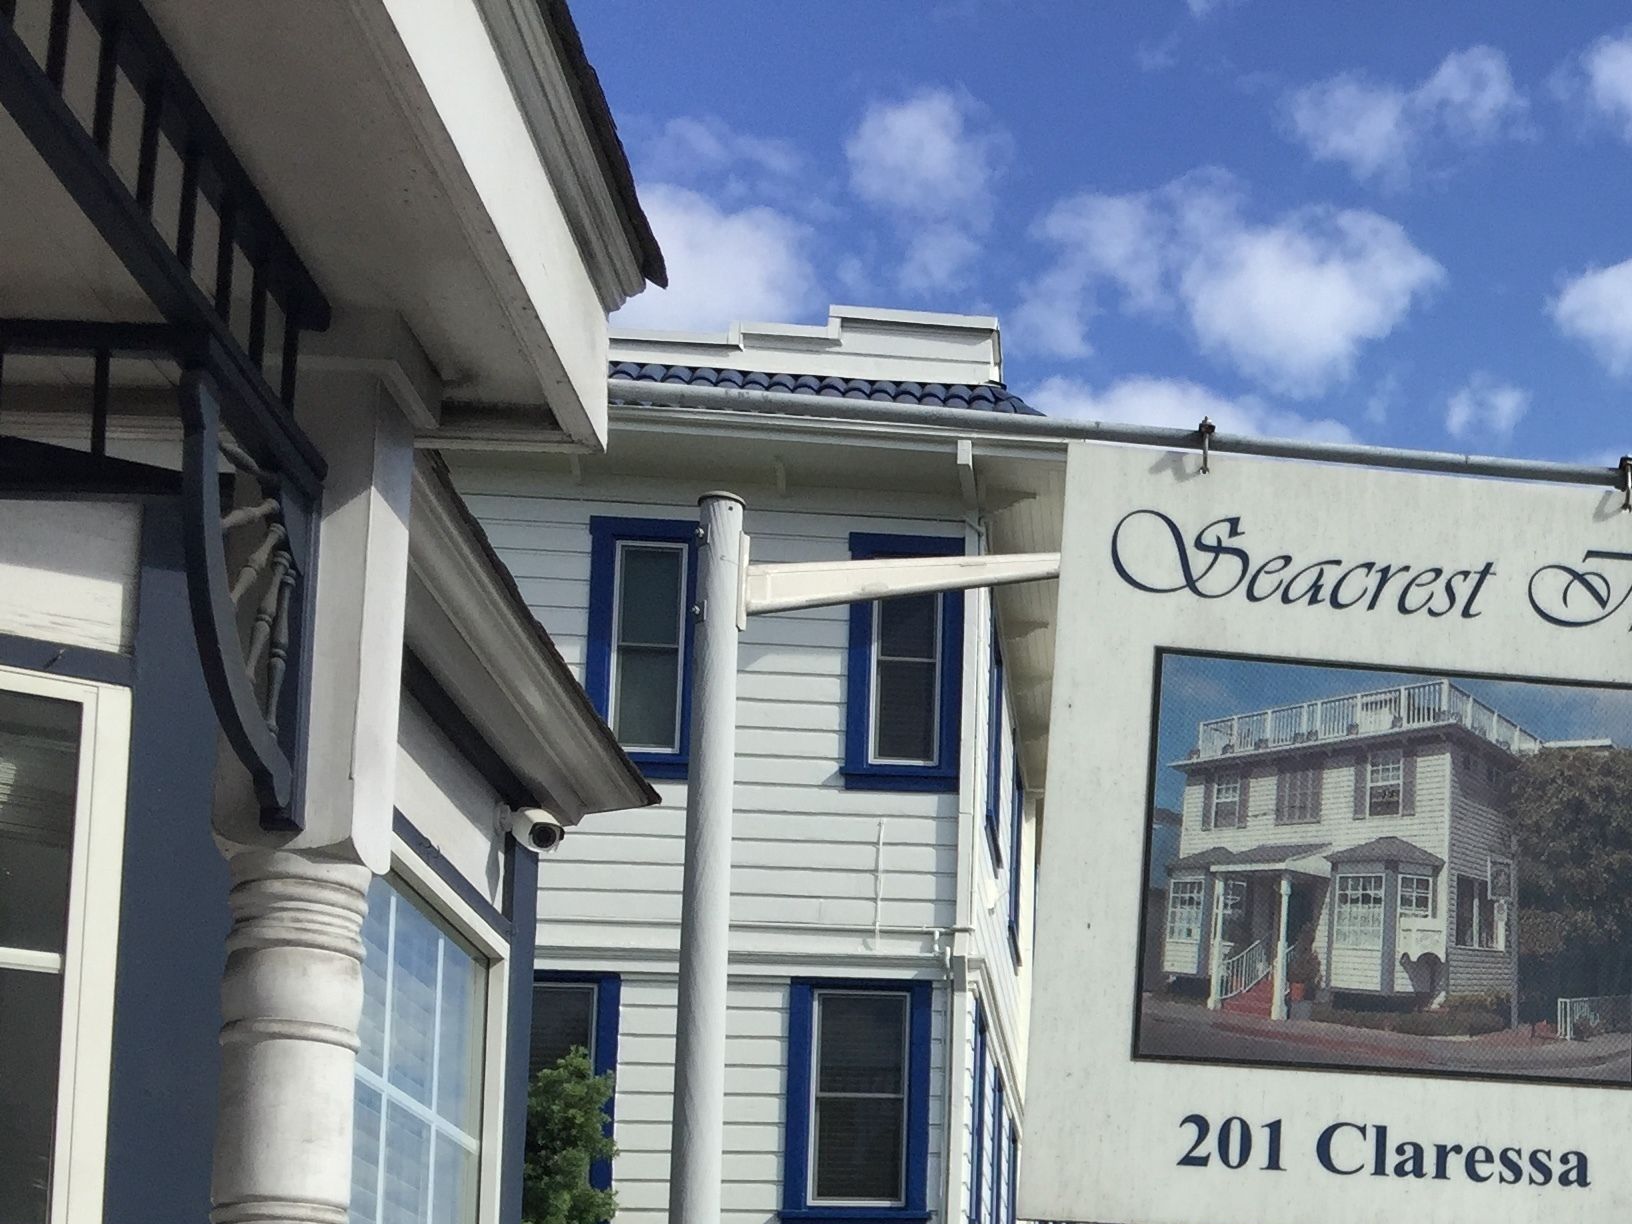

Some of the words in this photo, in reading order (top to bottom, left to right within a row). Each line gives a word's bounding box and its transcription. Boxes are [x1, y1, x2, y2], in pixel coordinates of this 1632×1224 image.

[1111, 509, 1497, 619] Seacrest
[1176, 1113, 1288, 1172] 201
[1316, 1121, 1592, 1188] Claressa
